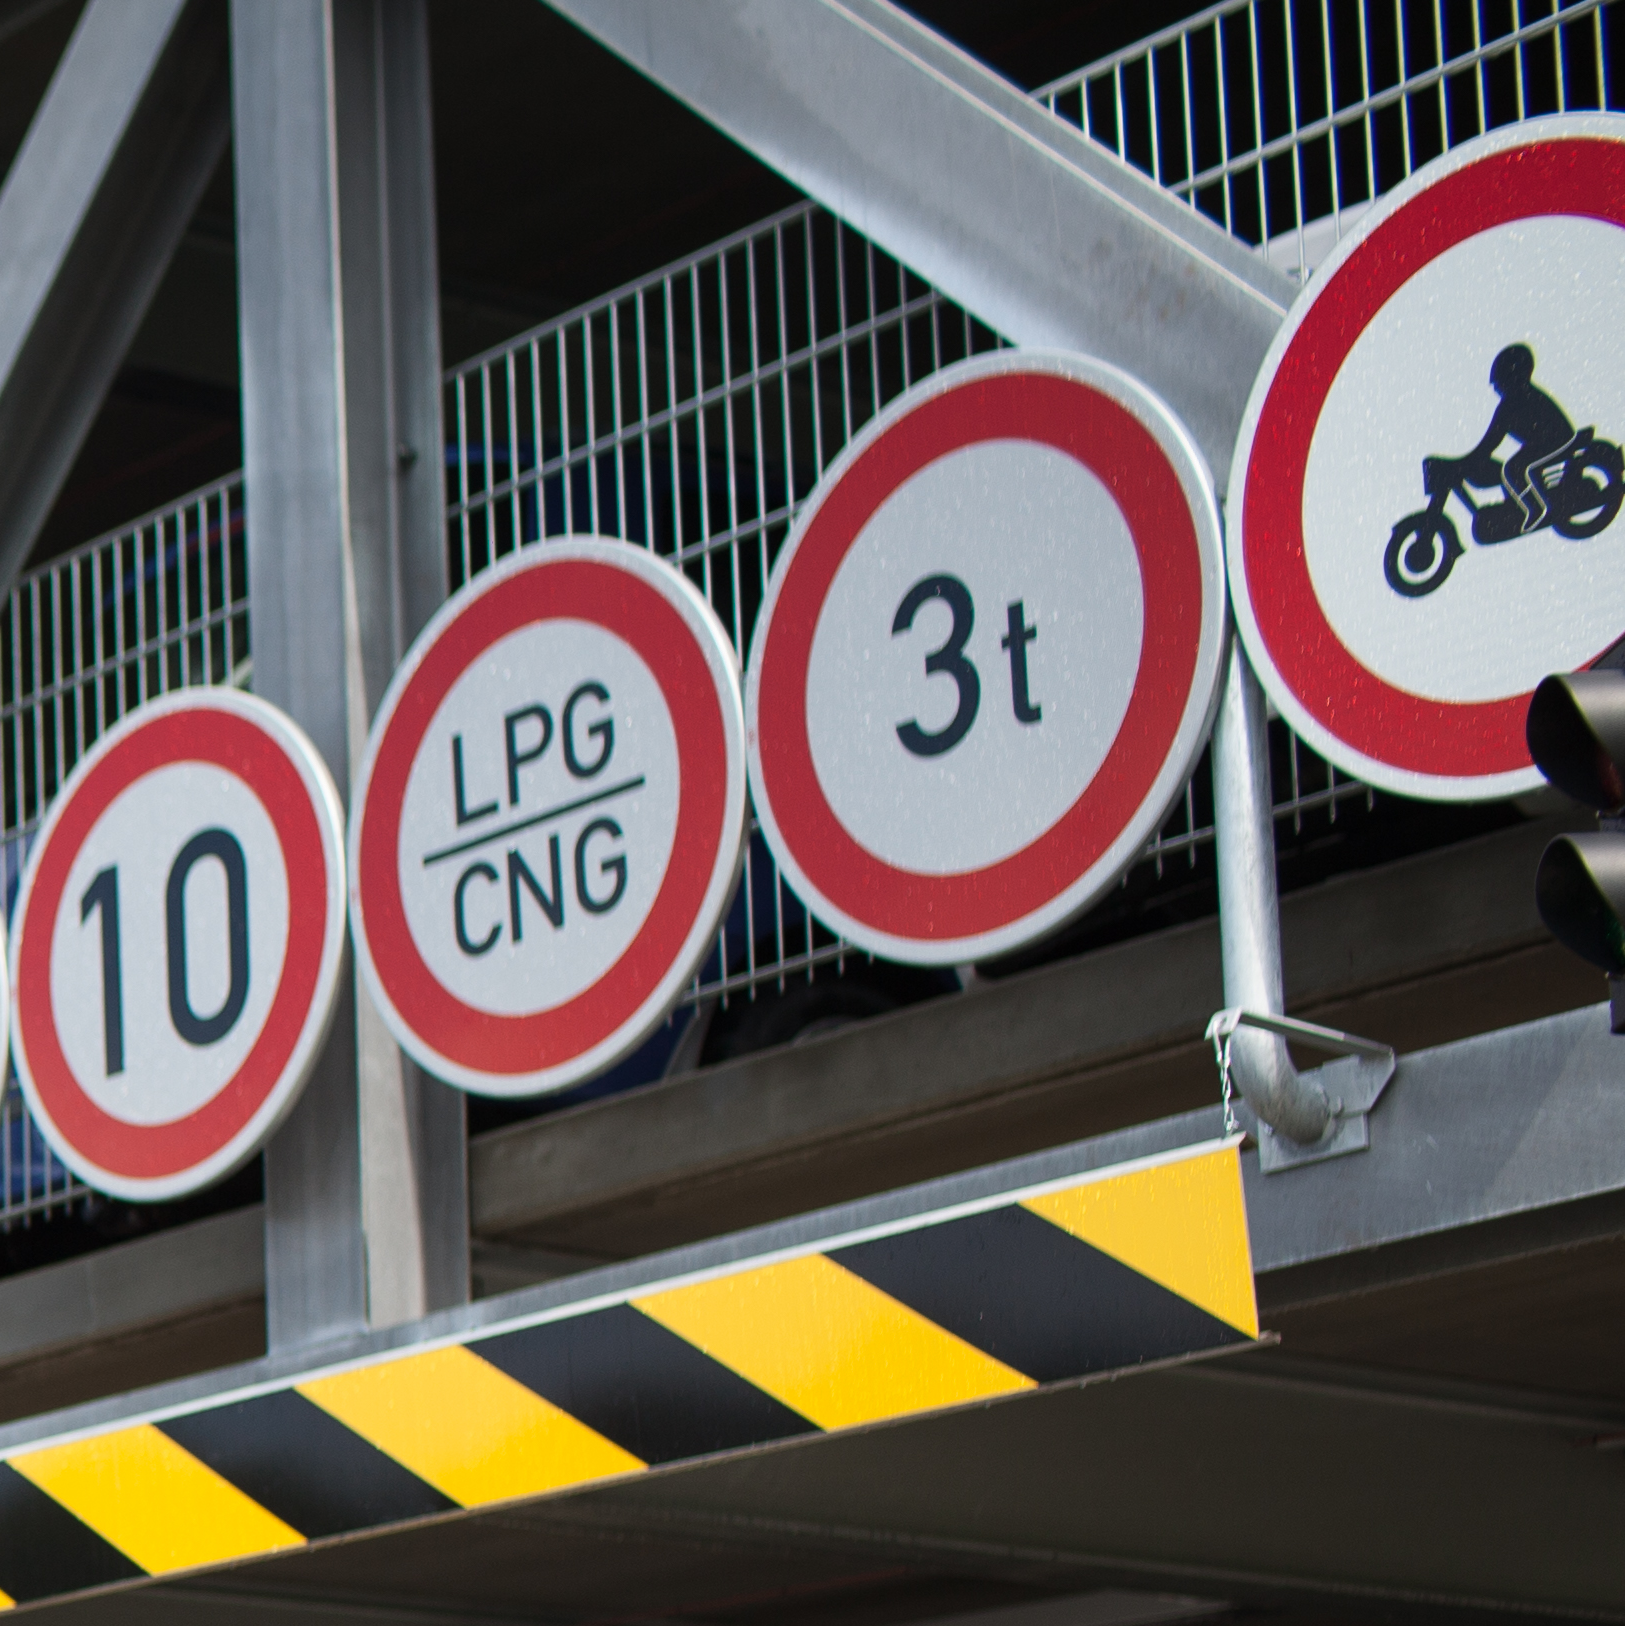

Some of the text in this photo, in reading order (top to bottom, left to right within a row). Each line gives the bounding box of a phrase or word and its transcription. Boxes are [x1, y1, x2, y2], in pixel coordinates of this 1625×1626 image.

[451, 680, 615, 829] LPG
[80, 827, 251, 1078] 10
[453, 817, 629, 957] CNG
